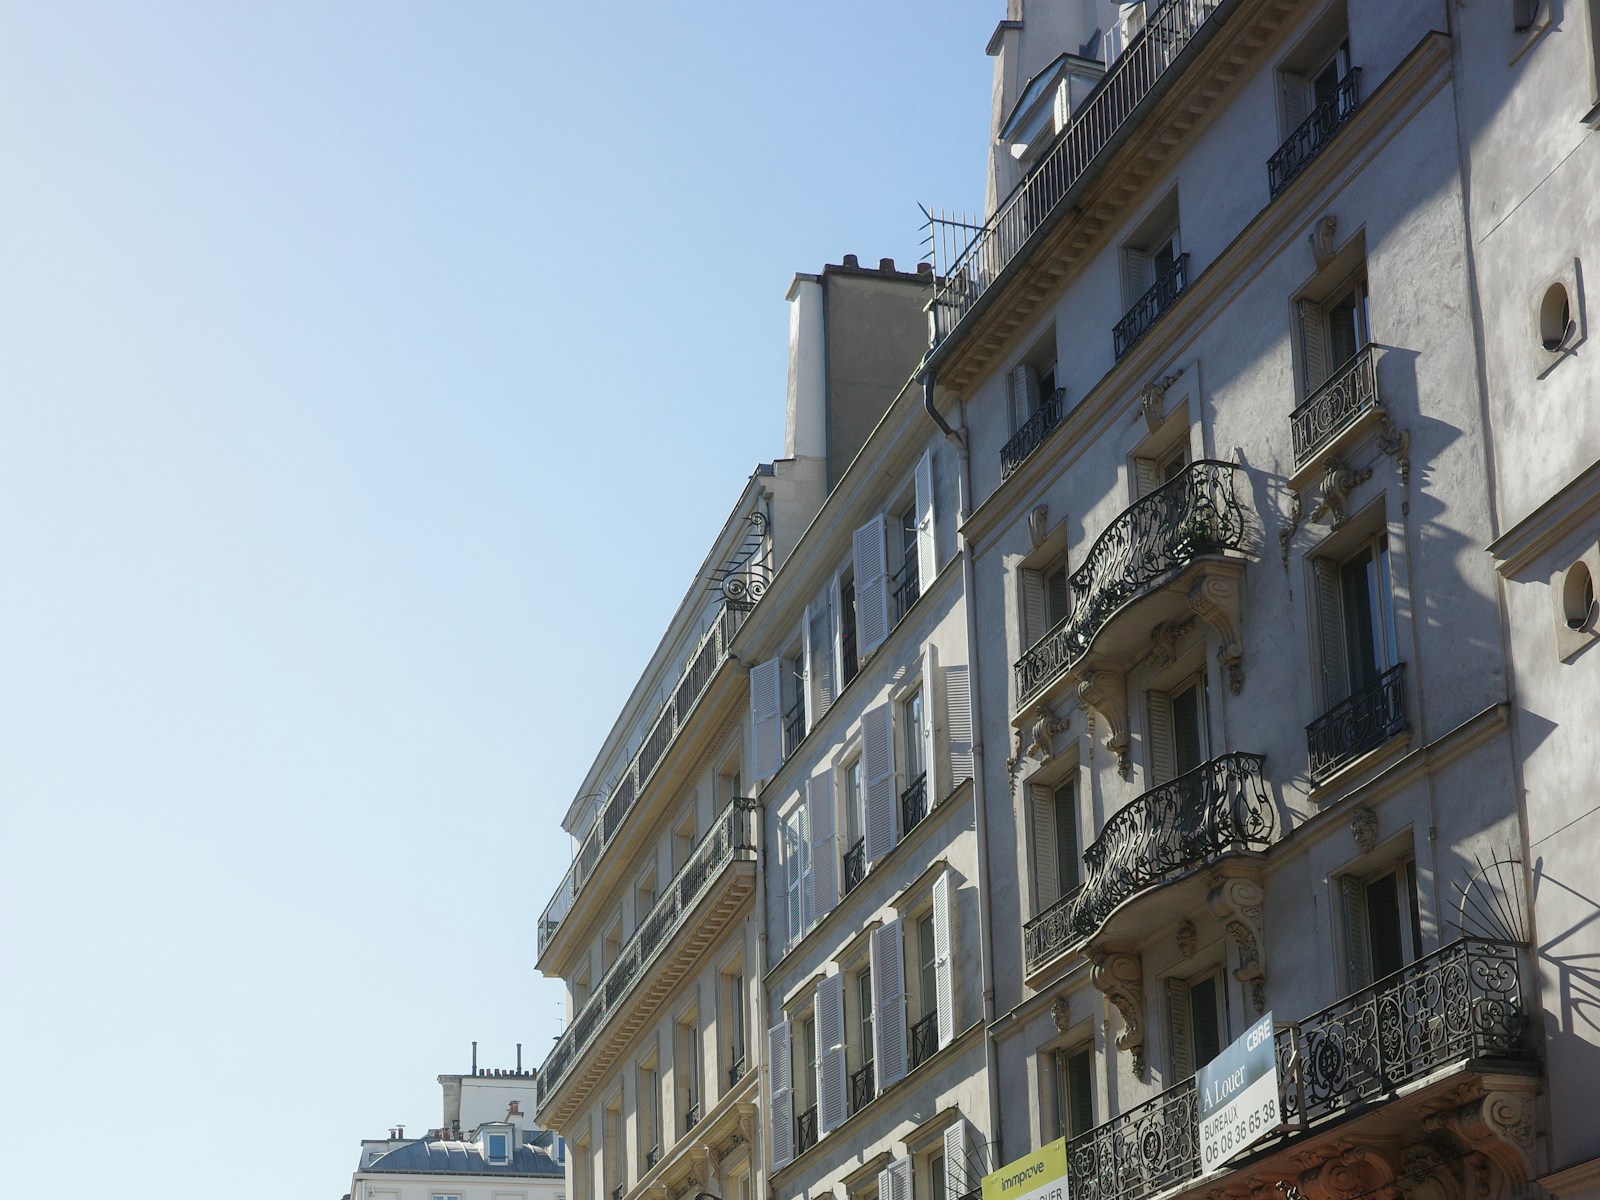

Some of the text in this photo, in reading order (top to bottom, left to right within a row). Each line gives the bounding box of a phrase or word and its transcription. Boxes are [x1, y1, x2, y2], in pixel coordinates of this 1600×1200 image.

[1246, 1018, 1271, 1052] CBRE
[1214, 1065, 1245, 1104] Louer
[1204, 1103, 1239, 1141] BUREAUX
[1205, 1141, 1219, 1164] 06
[1220, 1130, 1233, 1154] 08
[1235, 1120, 1247, 1144] 36
[1249, 1109, 1261, 1134] 65
[1263, 1099, 1276, 1124] 38
[1001, 1161, 1045, 1192] immprove
